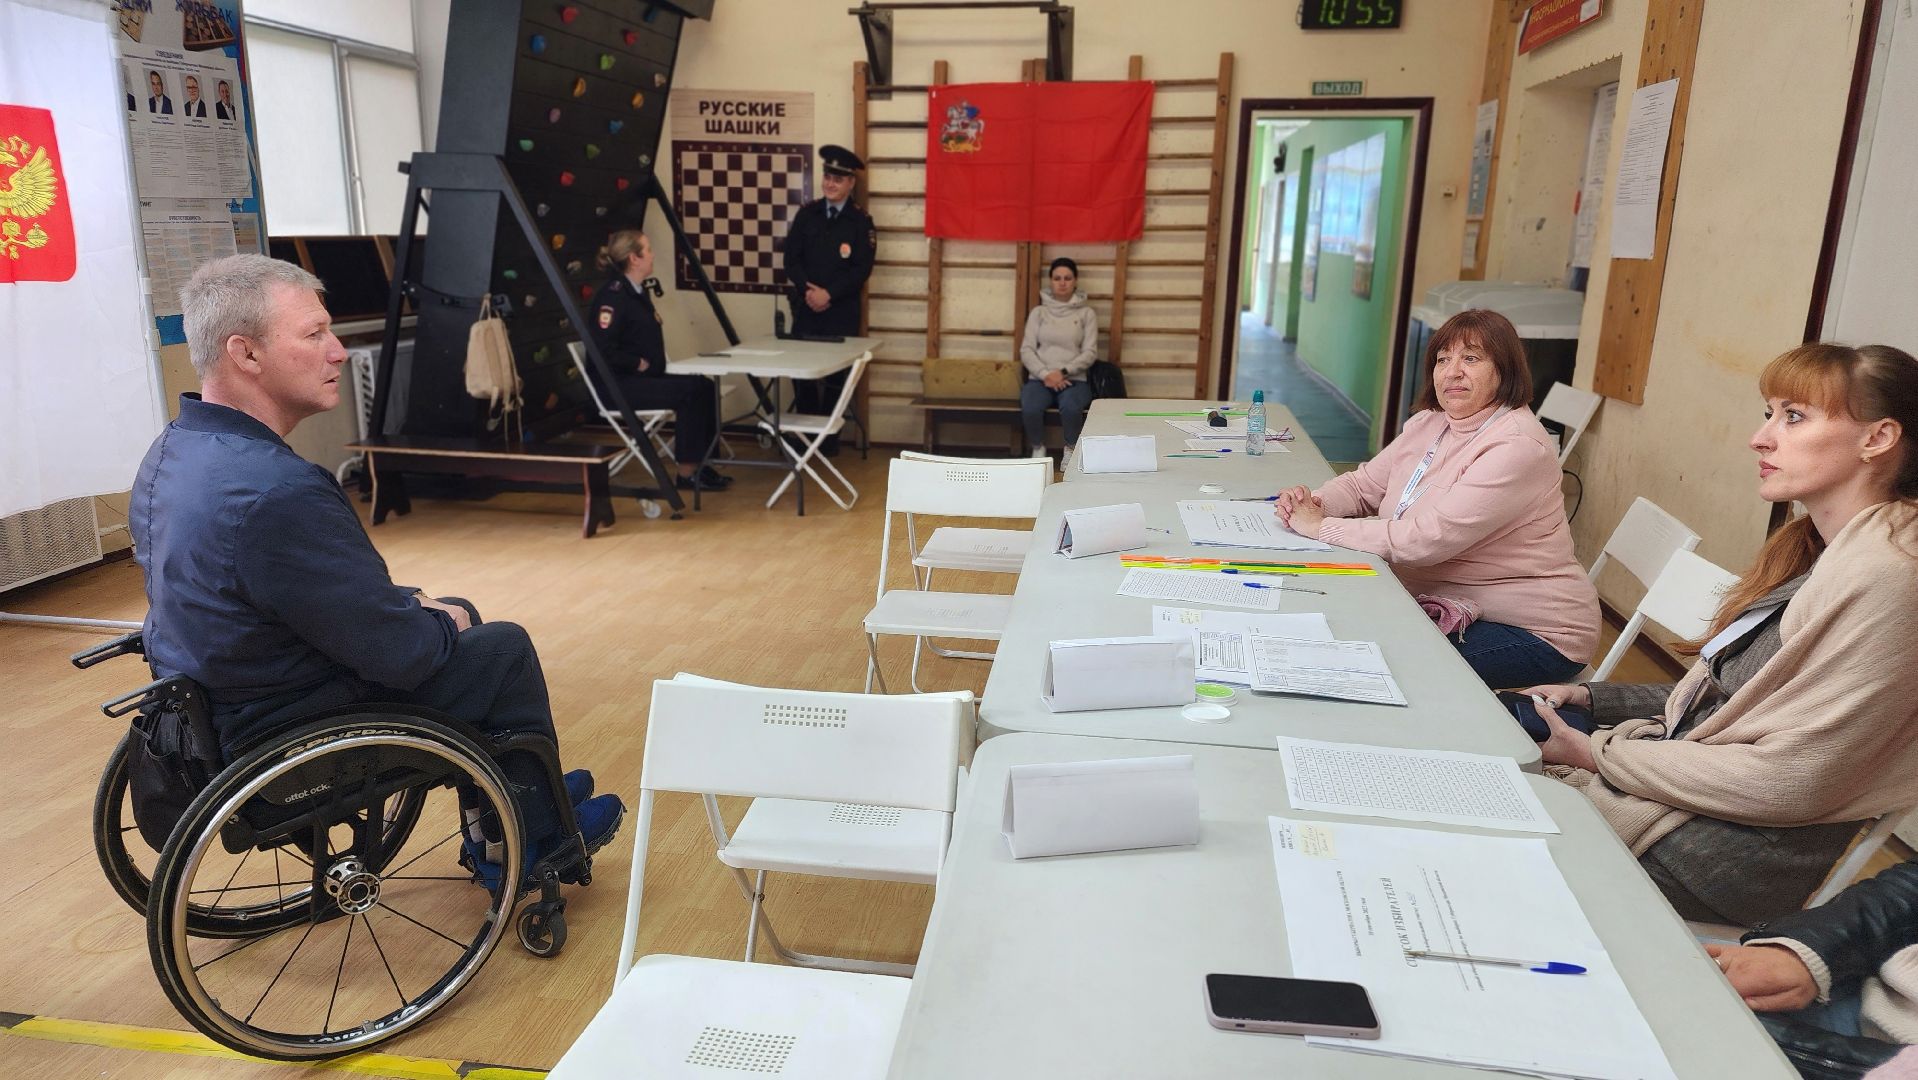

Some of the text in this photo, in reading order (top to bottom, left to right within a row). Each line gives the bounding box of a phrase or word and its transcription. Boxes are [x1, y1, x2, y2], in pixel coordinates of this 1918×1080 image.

[1314, 82, 1360, 95] ВЫХОД
[698, 100, 786, 118] РУССКИЕ
[705, 120, 781, 136] ШАШКИ
[1379, 876, 1419, 968] СПИСОК ИЗБИРАТЕЛЕЙ
